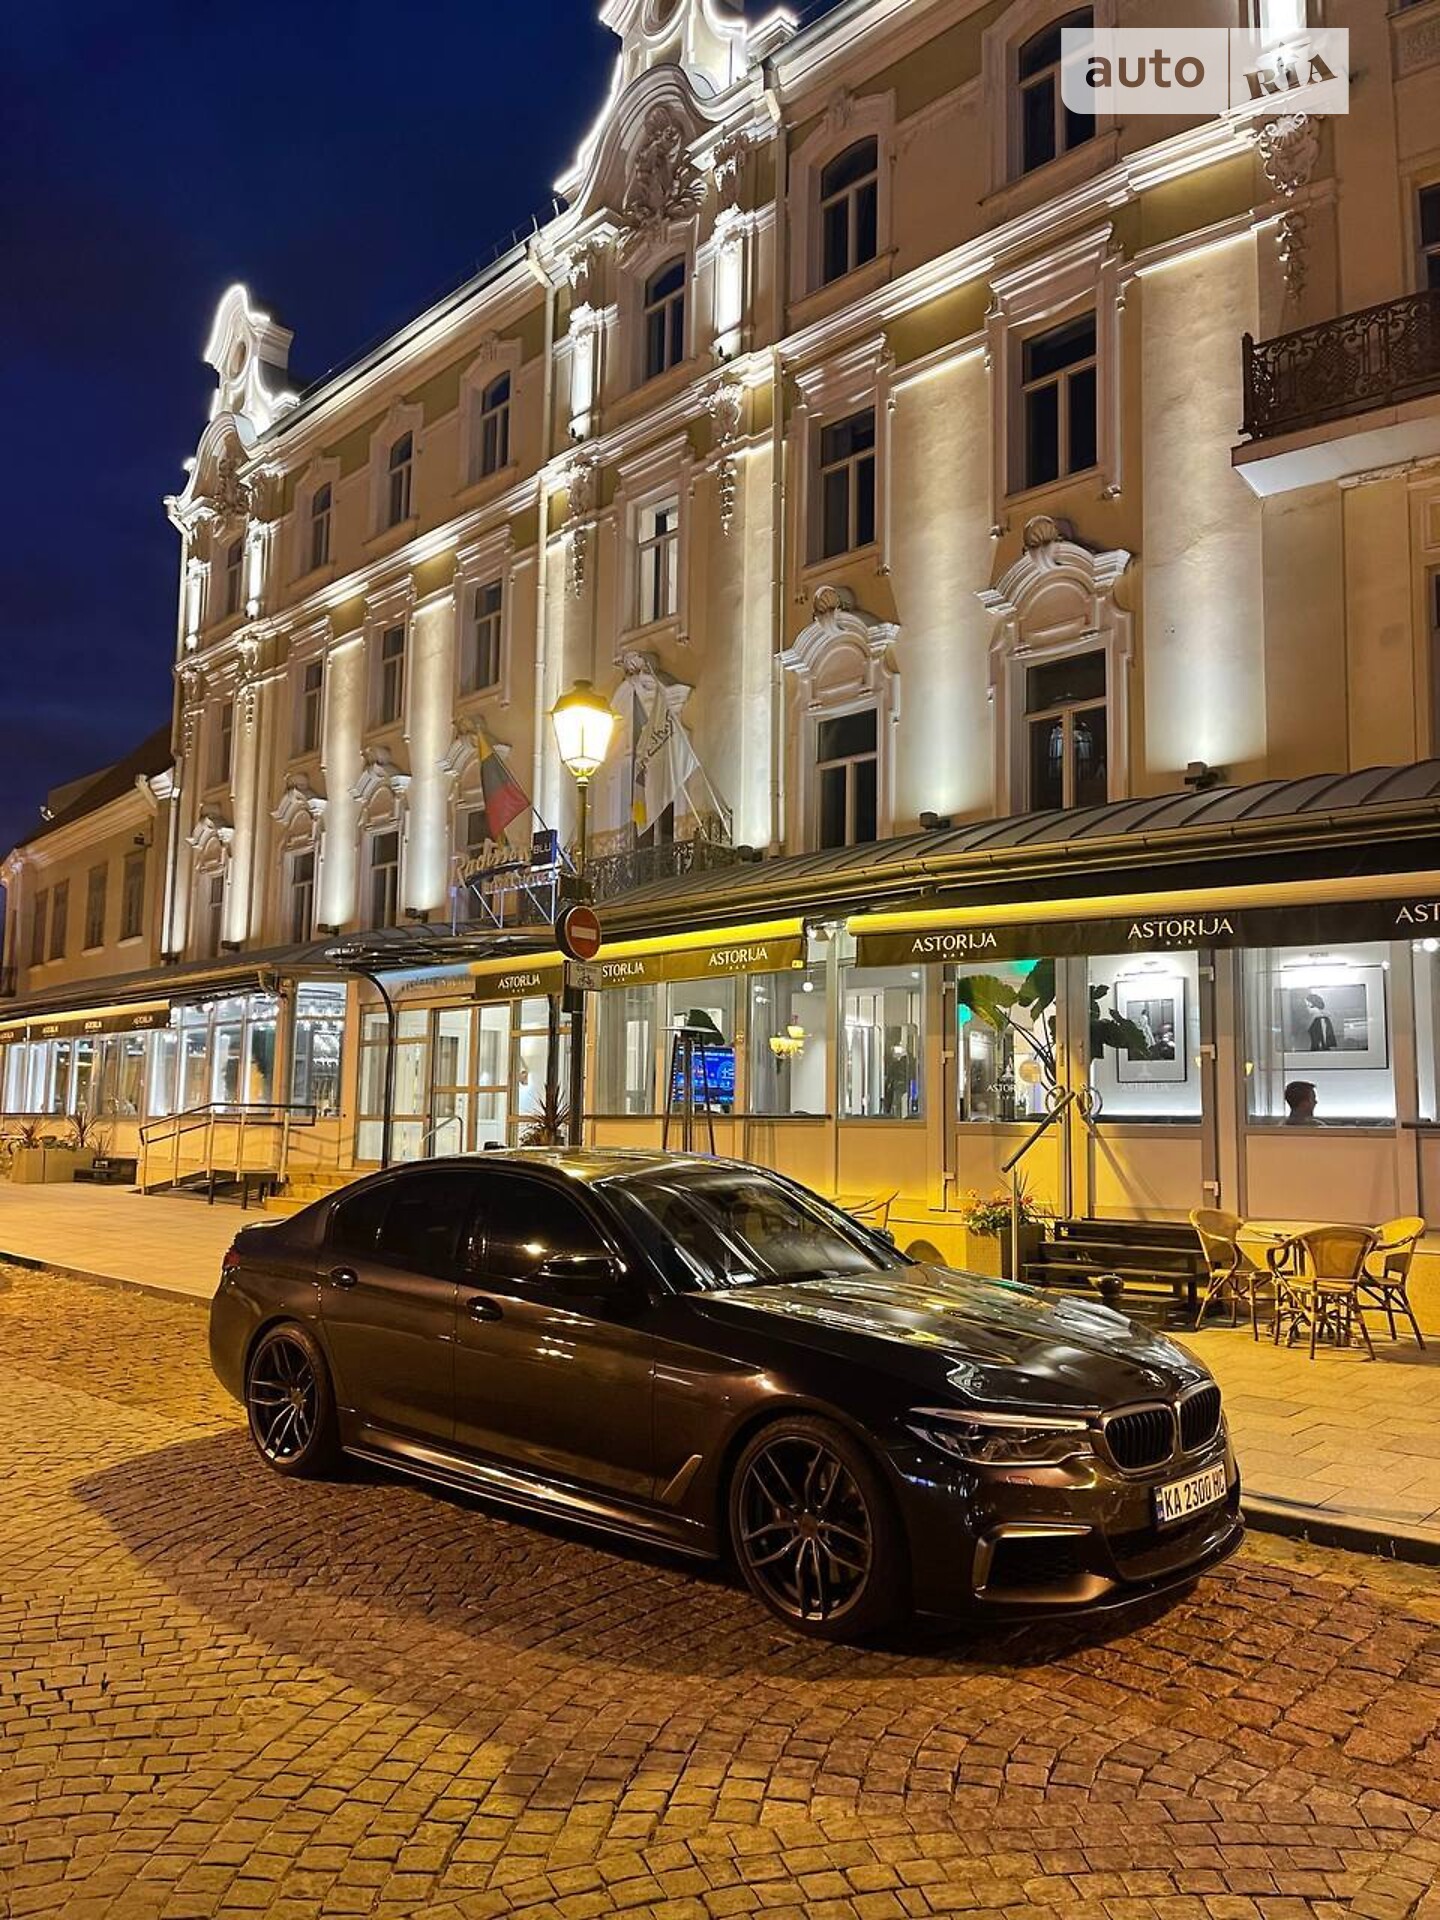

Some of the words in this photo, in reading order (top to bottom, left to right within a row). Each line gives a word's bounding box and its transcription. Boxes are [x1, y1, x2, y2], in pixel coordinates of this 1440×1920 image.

[1127, 917, 1234, 940] ASTORIJA
[912, 932, 997, 953] ASTORIJA
[708, 947, 769, 967] ASTORIJA
[602, 961, 645, 978] STORIJA
[497, 972, 541, 990] ASTORIJA
[1164, 1487, 1183, 1517] KA
[1184, 1475, 1211, 1509] 2300
